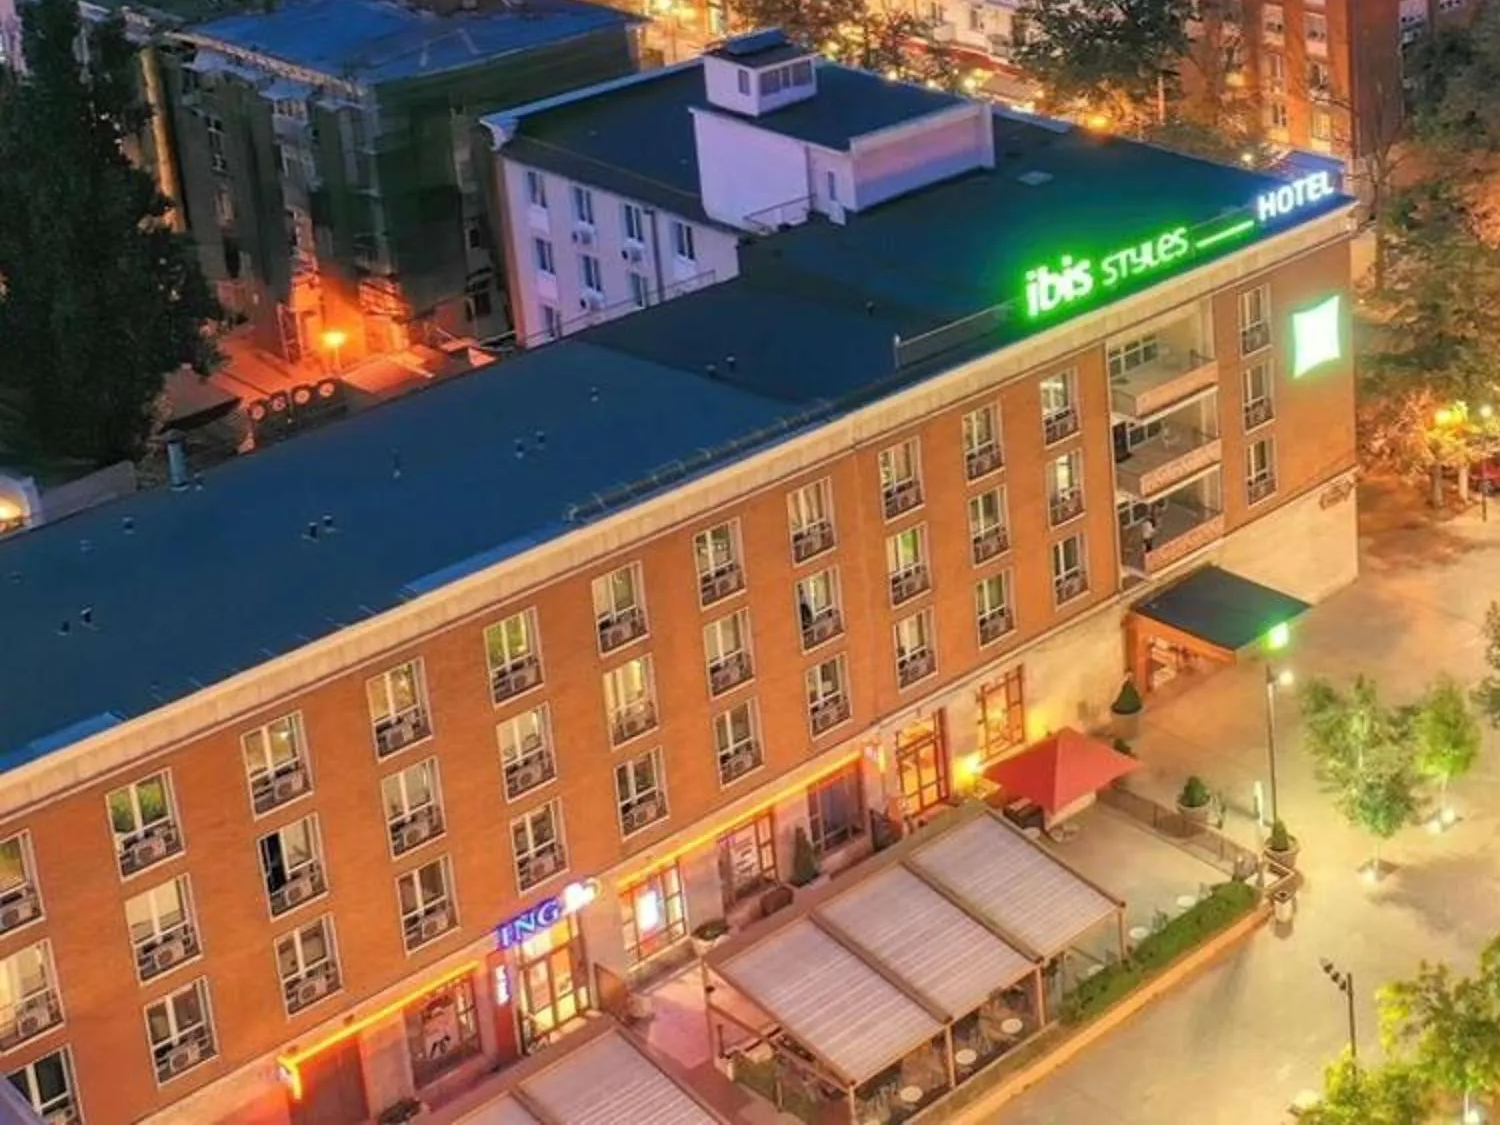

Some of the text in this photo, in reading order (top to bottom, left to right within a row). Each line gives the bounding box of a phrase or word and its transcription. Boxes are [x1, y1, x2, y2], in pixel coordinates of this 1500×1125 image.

[1024, 255, 1093, 317] ibis
[1257, 172, 1334, 221] HOTEL
[499, 898, 560, 948] ING
